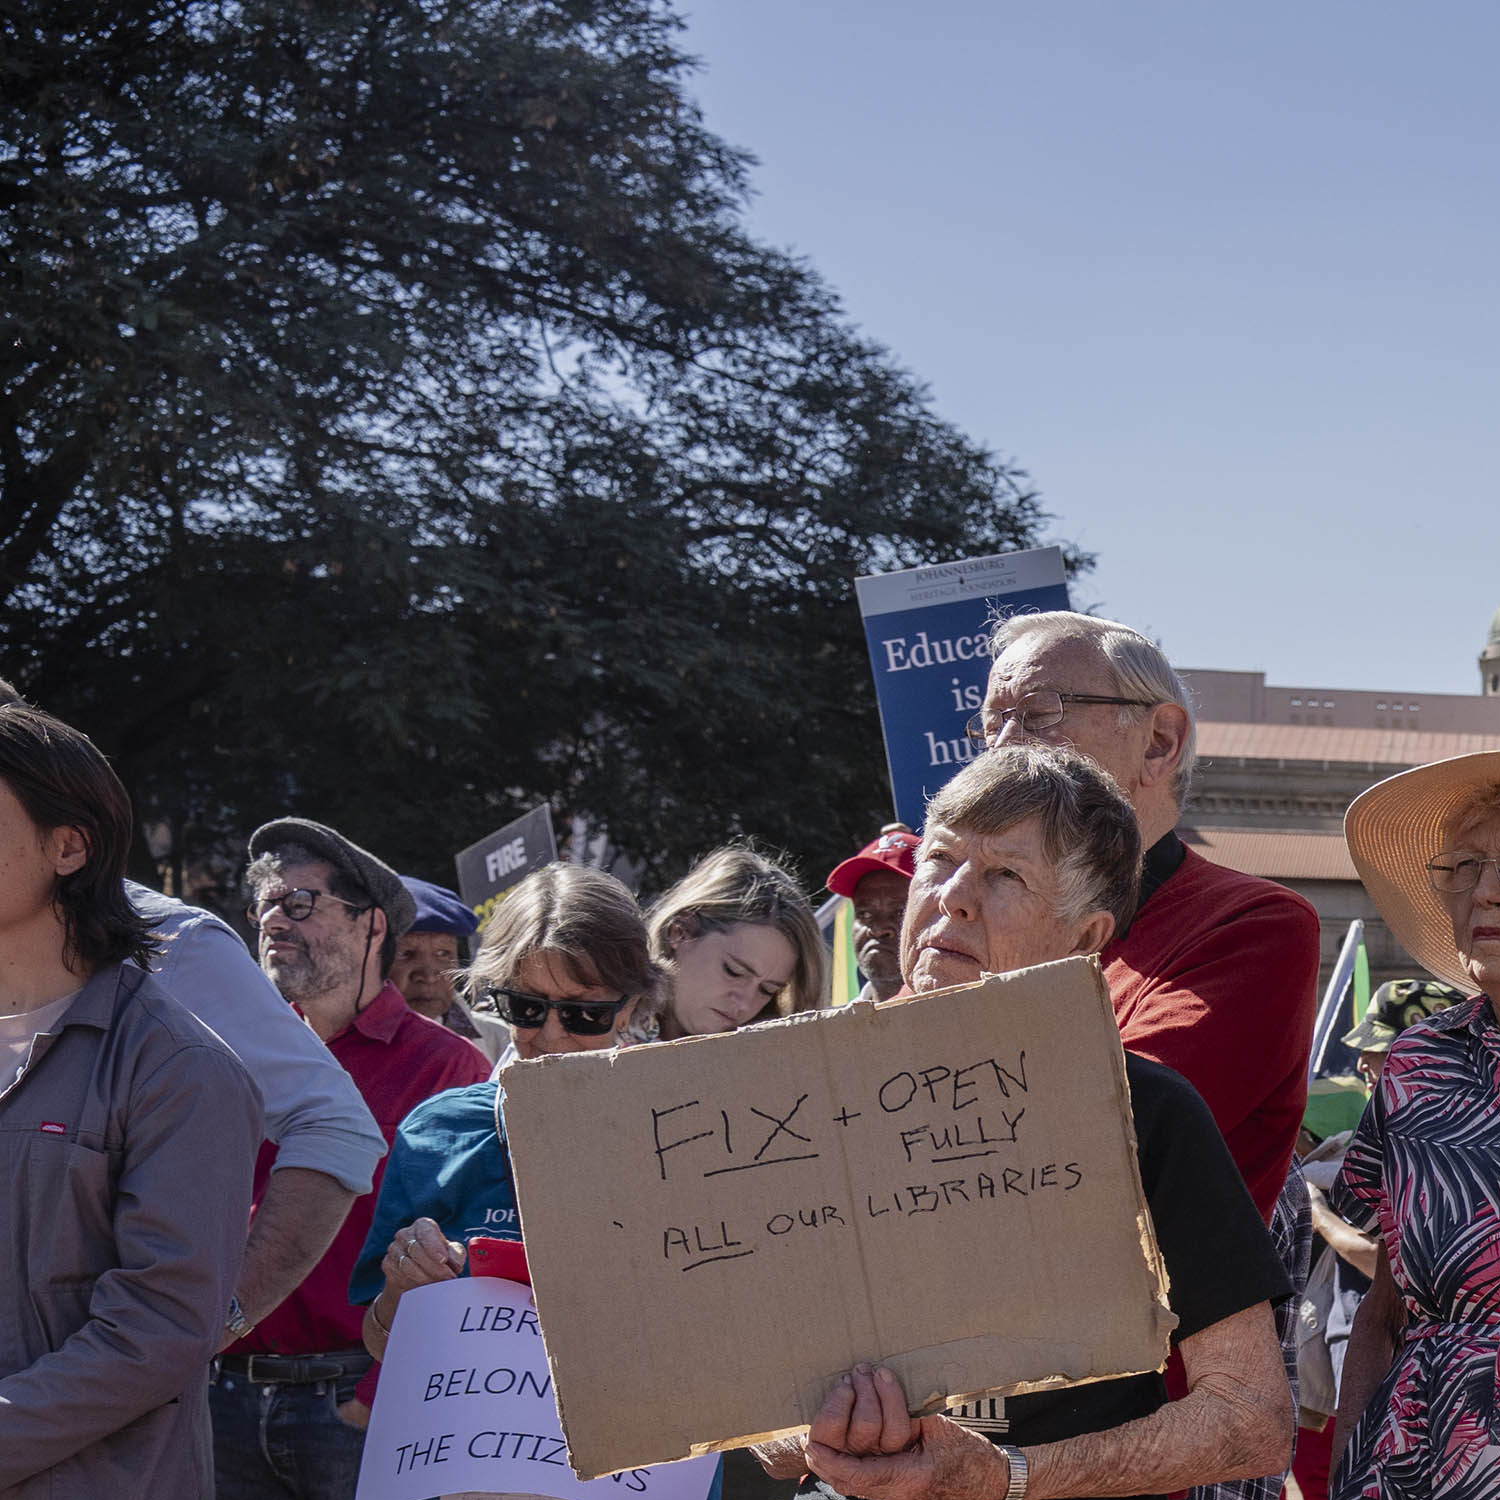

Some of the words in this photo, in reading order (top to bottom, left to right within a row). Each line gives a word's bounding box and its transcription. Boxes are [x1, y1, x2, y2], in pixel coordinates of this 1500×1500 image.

[915, 558, 1006, 584] JOHANNESBURG
[881, 632, 995, 673] Educa
[951, 678, 983, 712] is
[486, 837, 528, 882] FIRE
[651, 1094, 812, 1180] FIX
[833, 1106, 862, 1126] +
[879, 1050, 1029, 1112] OPEN
[663, 1221, 742, 1259] ALL
[767, 1205, 846, 1236] OUR
[868, 1162, 1083, 1218] LIBRARIES
[459, 1305, 545, 1337] LIBR
[424, 1367, 552, 1402] BELON
[396, 1434, 456, 1475] THE
